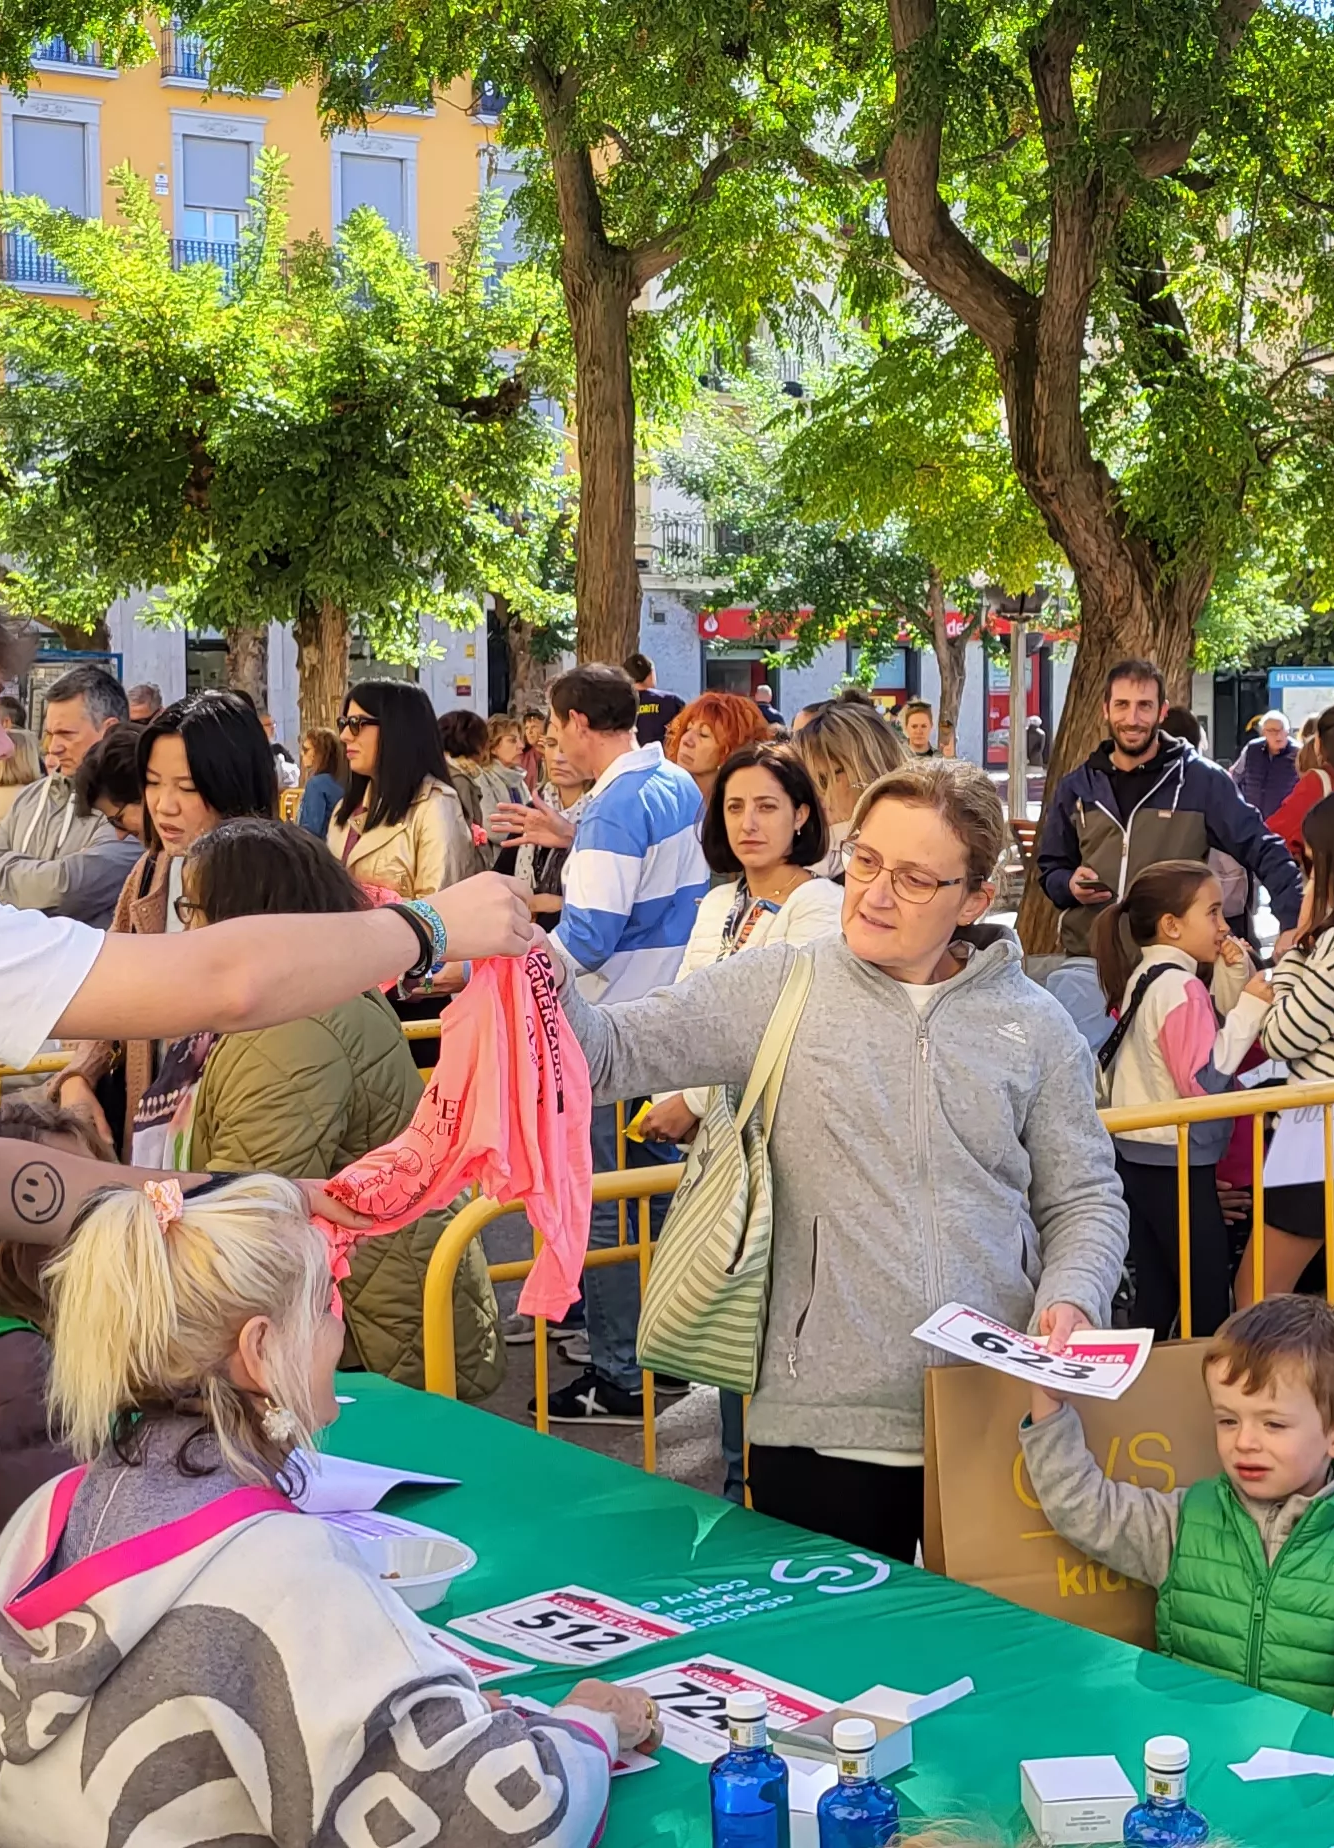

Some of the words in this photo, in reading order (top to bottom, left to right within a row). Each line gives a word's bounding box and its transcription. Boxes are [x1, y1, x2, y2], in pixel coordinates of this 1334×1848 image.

[1276, 673, 1315, 682] HUESCA
[971, 1331, 1096, 1379] 623
[553, 1598, 604, 1620] CONTRA
[513, 1610, 630, 1652] 512
[685, 1669, 741, 1694] CONTRA
[765, 1699, 809, 1721] ÁNCER
